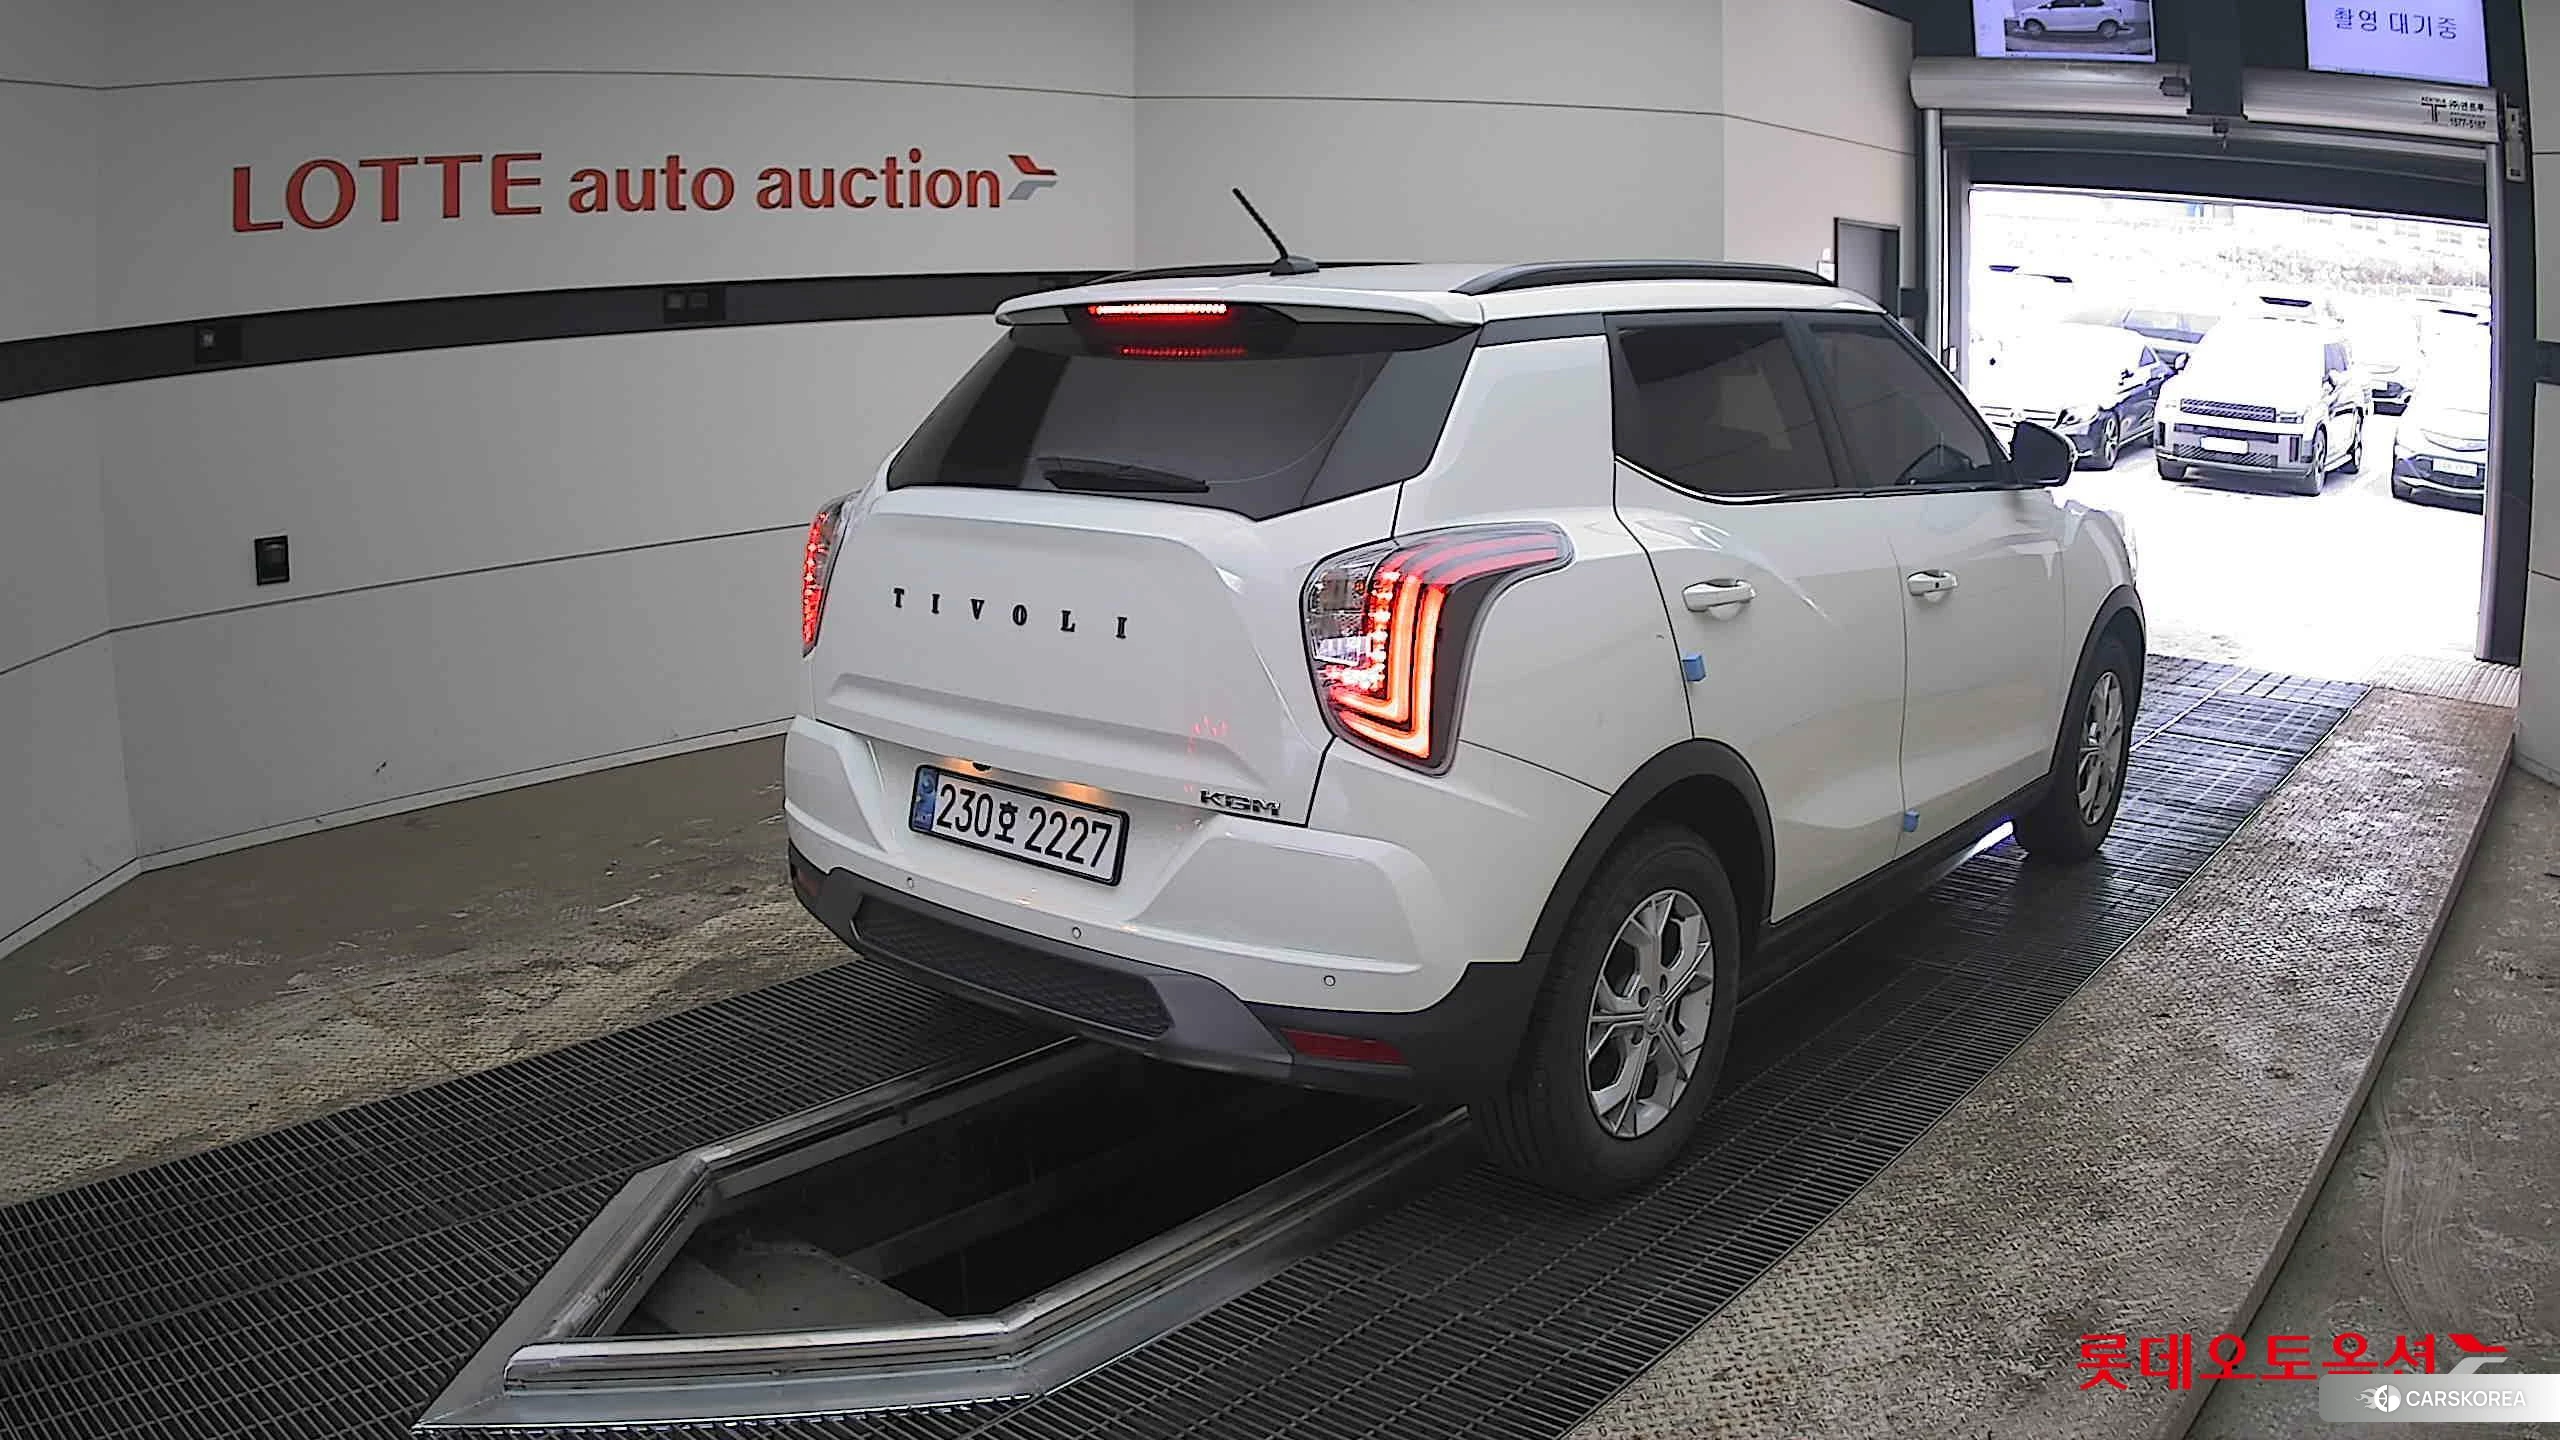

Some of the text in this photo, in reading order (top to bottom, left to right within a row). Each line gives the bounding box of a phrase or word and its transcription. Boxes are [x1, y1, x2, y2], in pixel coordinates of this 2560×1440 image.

[2335, 7, 2457, 40] 촬영 대기중
[232, 147, 1002, 232] LOTTE auto auction
[893, 587, 1128, 639] TIVOLI
[936, 783, 1113, 868] 230호 2227
[1200, 788, 1280, 816] KGM
